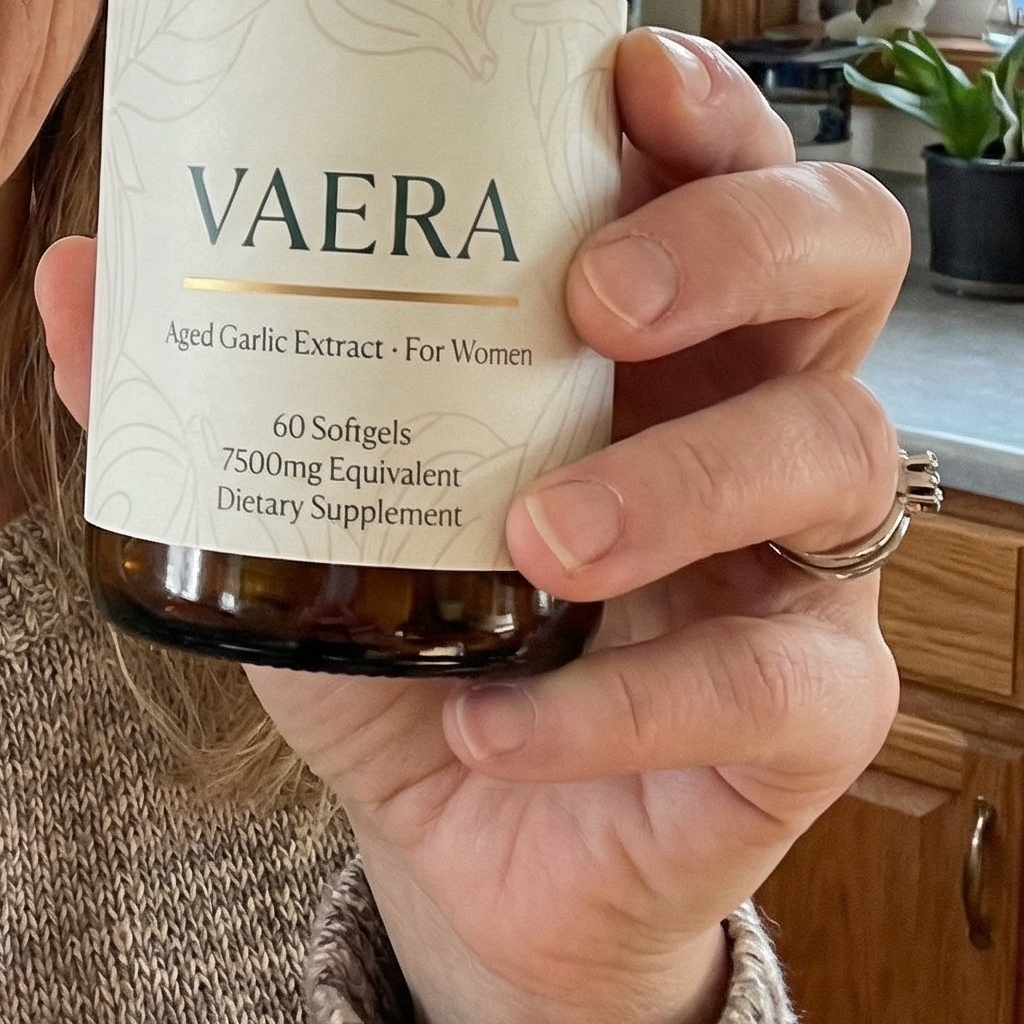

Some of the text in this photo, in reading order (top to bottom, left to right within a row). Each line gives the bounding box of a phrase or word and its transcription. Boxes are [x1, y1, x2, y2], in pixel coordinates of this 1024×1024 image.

[187, 165, 520, 263] VAERA
[165, 320, 214, 352] Aged
[219, 323, 288, 354] Garlic
[294, 329, 384, 360] Extract
[405, 336, 445, 363] For
[451, 338, 533, 366] Women
[273, 412, 412, 451] 60 Softgels
[222, 447, 462, 490] 7500mg Equivalent
[217, 485, 463, 531] Dietary Supplement
